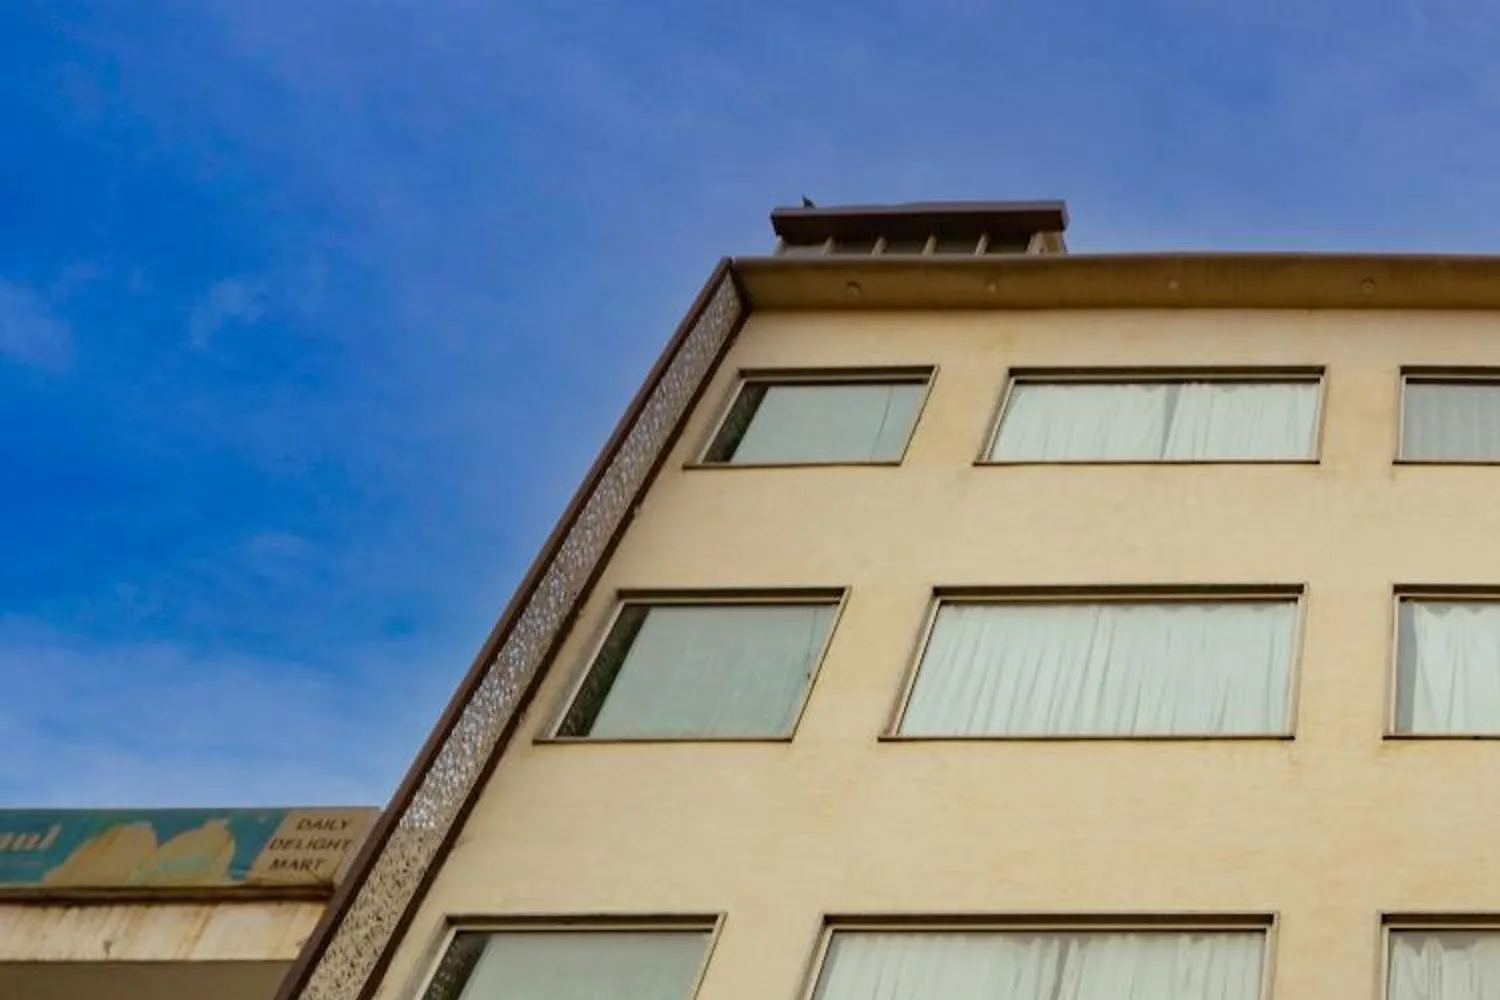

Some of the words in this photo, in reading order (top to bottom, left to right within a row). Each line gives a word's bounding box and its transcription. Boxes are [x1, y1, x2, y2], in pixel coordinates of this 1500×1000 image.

[296, 818, 352, 831] DAILY
[268, 838, 354, 851] DELIGHT
[268, 858, 327, 871] MART
